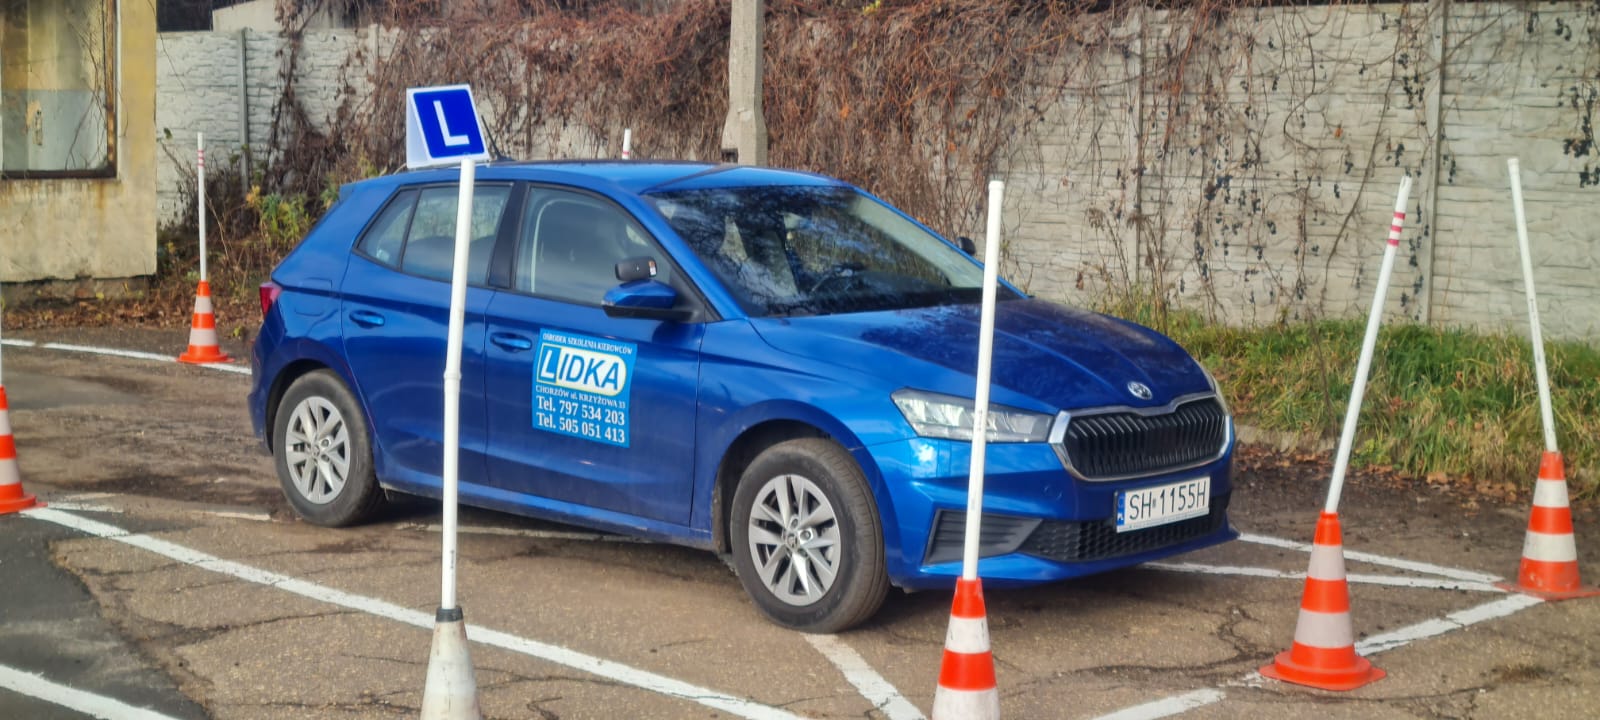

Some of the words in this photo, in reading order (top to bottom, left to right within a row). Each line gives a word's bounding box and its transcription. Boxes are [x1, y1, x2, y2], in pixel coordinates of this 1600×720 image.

[433, 100, 470, 147] L
[540, 349, 619, 391] LIDKA
[535, 384, 569, 398] CHORZÓW
[536, 395, 556, 412] Tel.
[559, 400, 579, 417] 797
[581, 405, 602, 422] 534
[604, 409, 625, 426] 203
[536, 412, 556, 429] Tel.
[559, 418, 579, 434] 505
[581, 422, 602, 438] 051
[604, 427, 625, 443] 413
[1129, 491, 1152, 520] SH
[1160, 480, 1207, 515] 1155H
